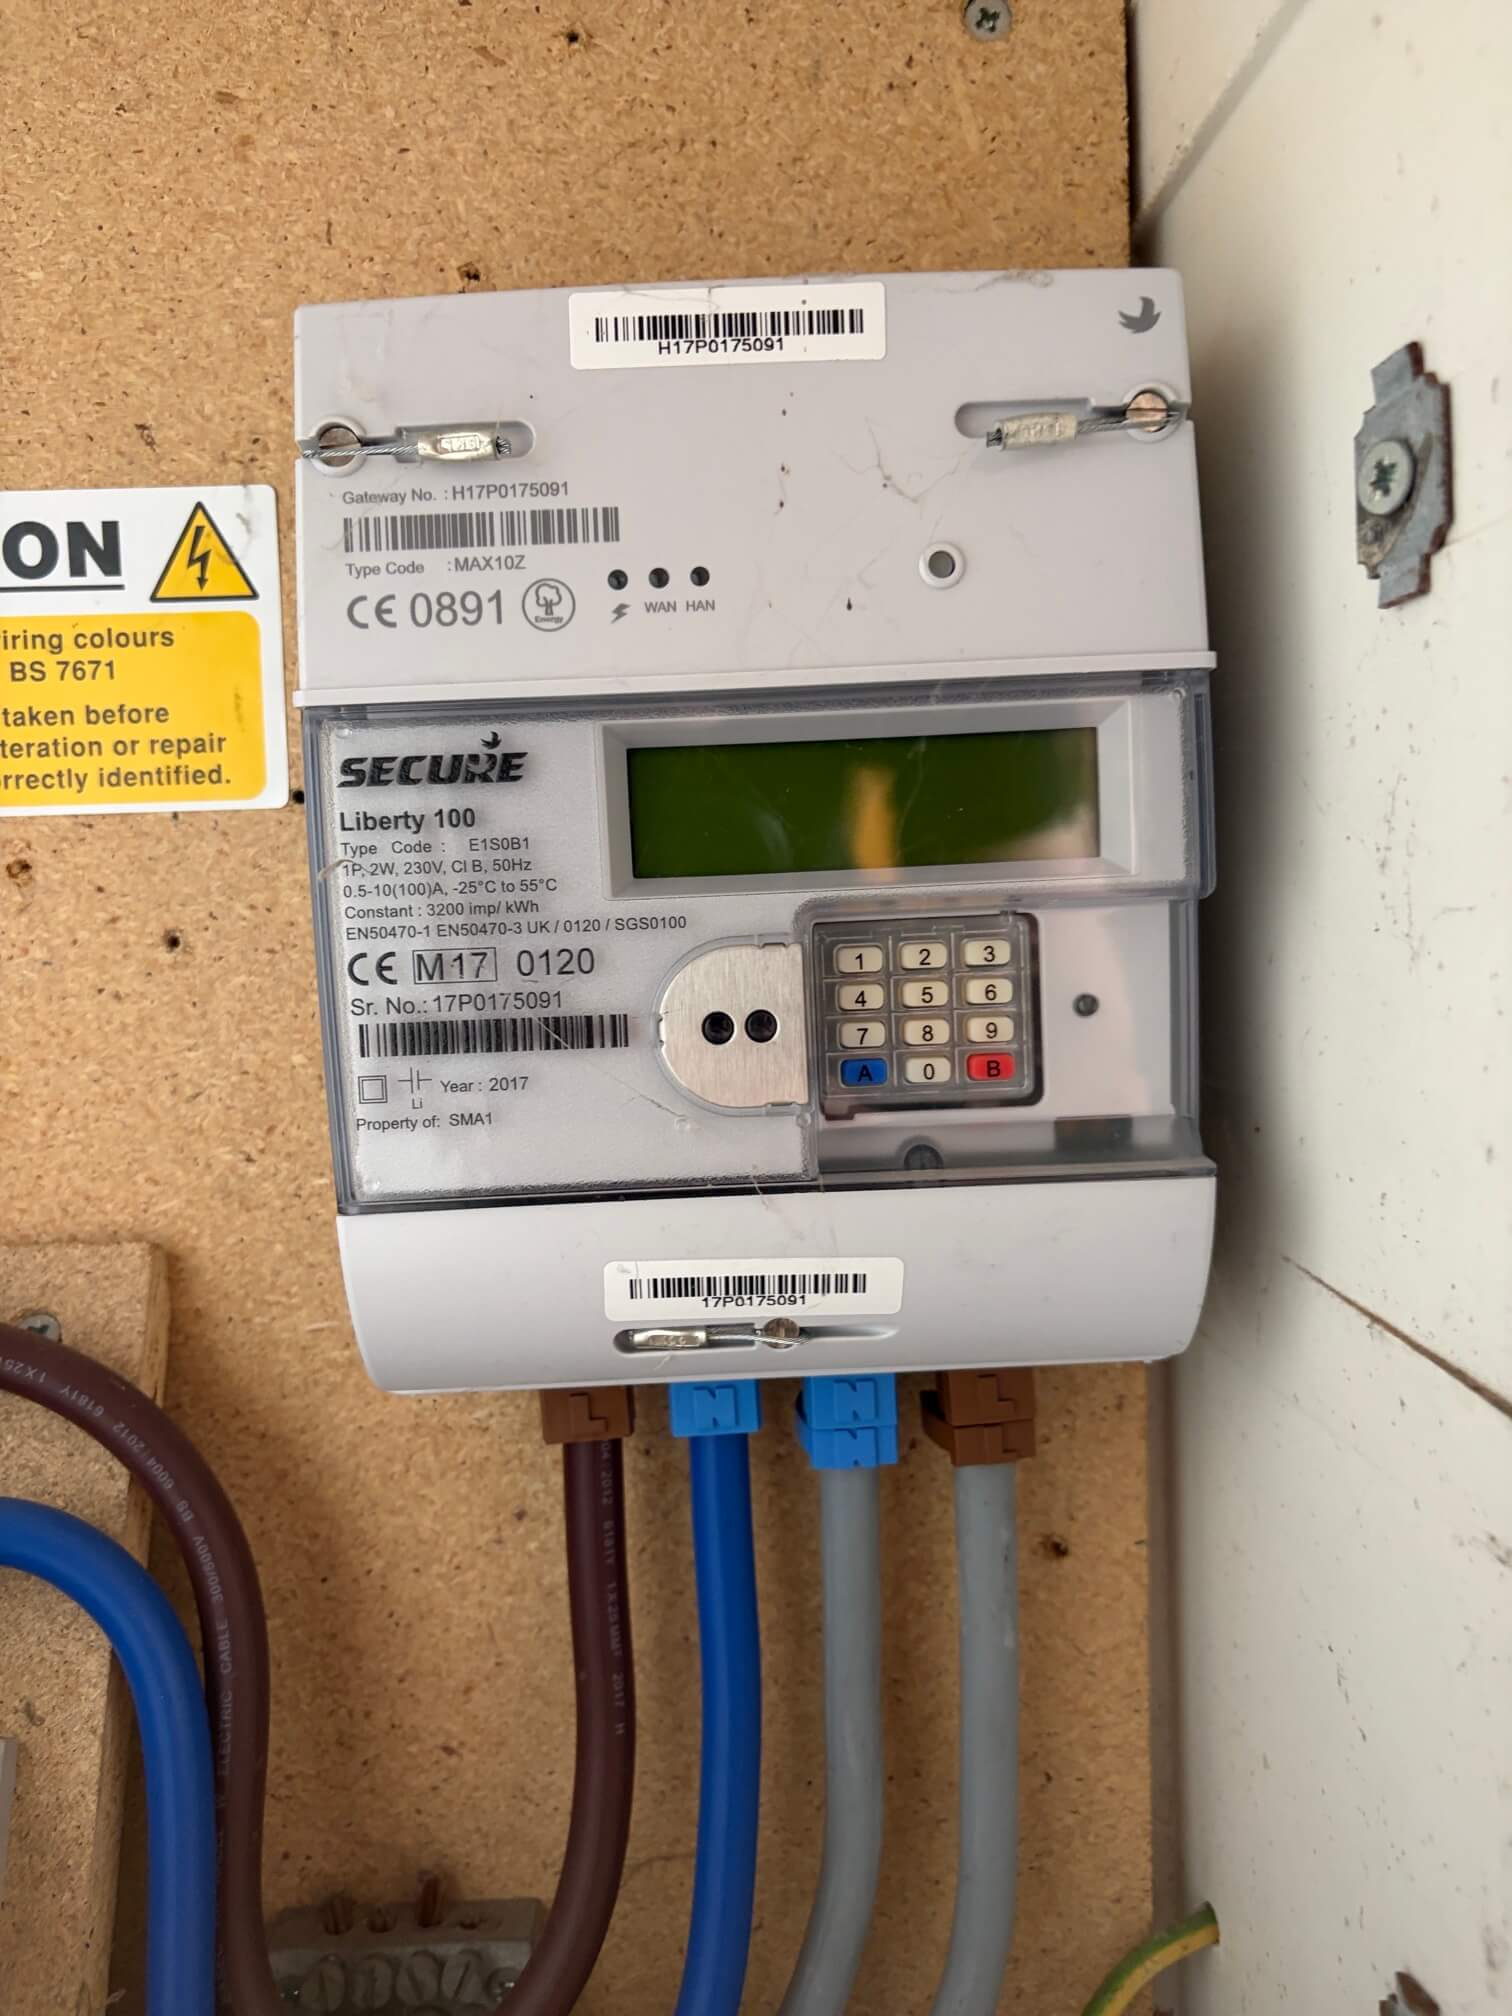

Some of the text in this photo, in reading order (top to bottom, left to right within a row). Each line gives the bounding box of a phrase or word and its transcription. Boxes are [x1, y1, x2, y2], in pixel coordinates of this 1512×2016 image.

[658, 336, 785, 355] H17P0175091
[342, 488, 407, 505] Gateway
[411, 487, 437, 502] No.
[2, 520, 122, 580] ON
[345, 562, 381, 579] Type
[385, 560, 425, 576] Code
[409, 589, 503, 629] 0891
[644, 600, 677, 614] WAN
[686, 598, 716, 612] HAN
[0, 628, 175, 655] iring colours
[10, 660, 116, 682] BS 7671
[2, 704, 169, 727] taken before
[0, 733, 227, 760] teration or repair
[336, 751, 528, 788] SECURE
[0, 765, 232, 794] rrectly identified.
[339, 807, 476, 834] Liberty 100
[340, 843, 378, 858] Type
[391, 840, 432, 854] Code
[370, 862, 399, 877] 2W,
[403, 860, 447, 876] 230V,
[472, 859, 488, 874] B,
[492, 858, 532, 872] 50Hz
[453, 879, 497, 895] -25°C
[501, 880, 516, 893] to
[519, 878, 558, 892] 55°C
[344, 904, 414, 919] Constant
[426, 903, 464, 917] 3200
[505, 900, 540, 914] kWh
[346, 924, 431, 940] EN50470-1
[436, 922, 523, 938] EN50470-3
[527, 920, 550, 935] UK
[563, 918, 601, 933] 0120
[615, 916, 687, 931] SGS0100
[516, 948, 595, 977] 0120
[854, 953, 864, 970] 1
[919, 948, 931, 965] 2
[983, 945, 996, 962] 3
[855, 991, 867, 1007] 4
[921, 986, 934, 1003] 5
[984, 984, 997, 1001] 6
[350, 997, 379, 1016] Sr.
[432, 991, 562, 1013] 17P0175091
[856, 1028, 868, 1044] 7
[922, 1025, 934, 1041] 8
[985, 1022, 998, 1038] 9
[857, 1065, 873, 1082] A
[923, 1063, 935, 1080] 0
[987, 1060, 1001, 1077] B
[440, 1078, 474, 1094] Year
[488, 1076, 529, 1092] 2017
[356, 1112, 493, 1134] Property of: SMA1
[701, 1294, 806, 1308] 17P0175091
[219, 1620, 233, 1674] CABLE
